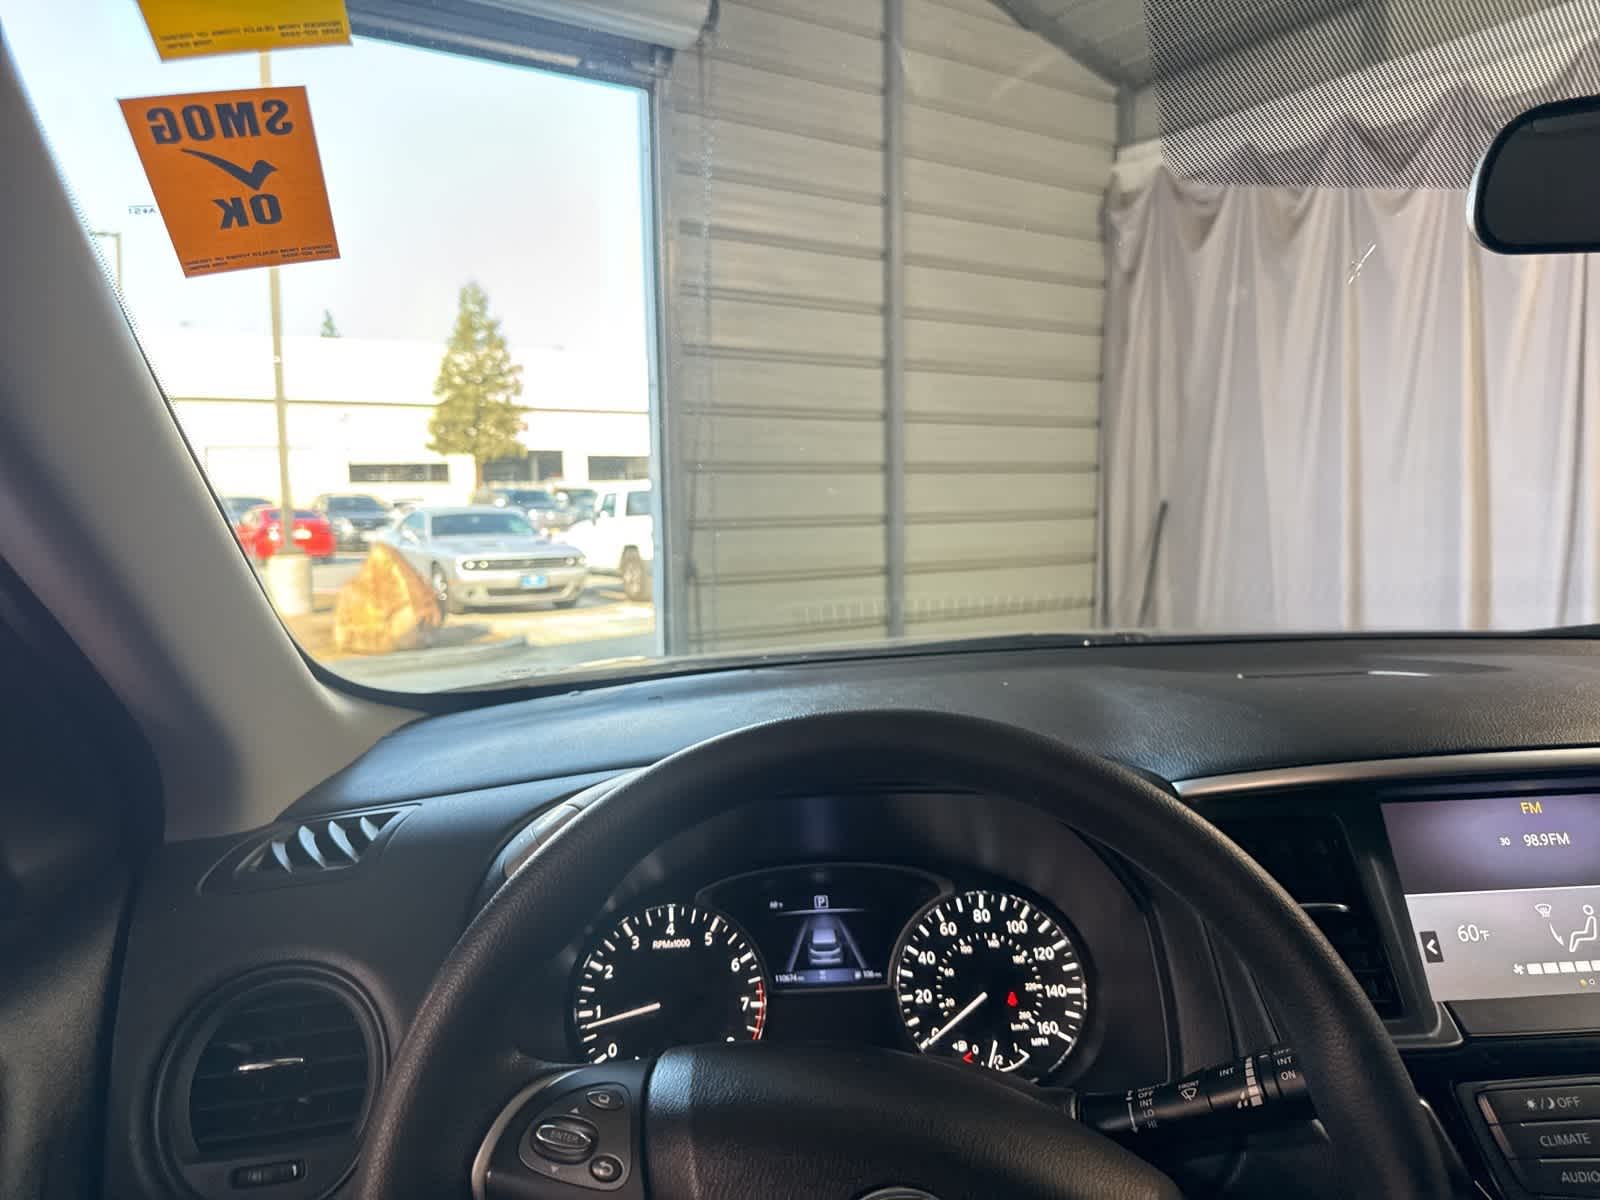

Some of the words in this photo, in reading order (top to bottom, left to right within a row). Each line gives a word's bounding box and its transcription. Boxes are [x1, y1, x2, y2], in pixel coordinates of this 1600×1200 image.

[1520, 801, 1543, 815] FM
[1523, 832, 1571, 848] 98.9FM
[972, 909, 991, 923] 80
[665, 923, 675, 936] 4
[939, 922, 958, 936] 60
[1006, 920, 1028, 934] 100
[631, 936, 640, 950] 3
[704, 932, 713, 946] 5
[918, 951, 936, 965] 40
[1033, 946, 1055, 961] 120
[731, 957, 740, 972] 6
[604, 965, 614, 979] 2
[914, 989, 933, 1003] 20
[1045, 984, 1067, 998] 140
[740, 997, 749, 1012] 7
[595, 1005, 601, 1019] 1
[1010, 1022, 1030, 1031] km/h
[1037, 1021, 1059, 1035] 160
[1030, 1037, 1049, 1047] MPH
[608, 1043, 617, 1058] 0
[972, 1044, 979, 1055] 0
[1276, 1056, 1293, 1066] INT
[1219, 1067, 1234, 1077] INT
[1280, 1070, 1297, 1081] ON
[1137, 1091, 1153, 1099] OFF
[1139, 1099, 1153, 1107] INT
[1557, 1096, 1581, 1109] OFF
[1143, 1108, 1154, 1119] LO
[1540, 1132, 1591, 1147] CLIMATE
